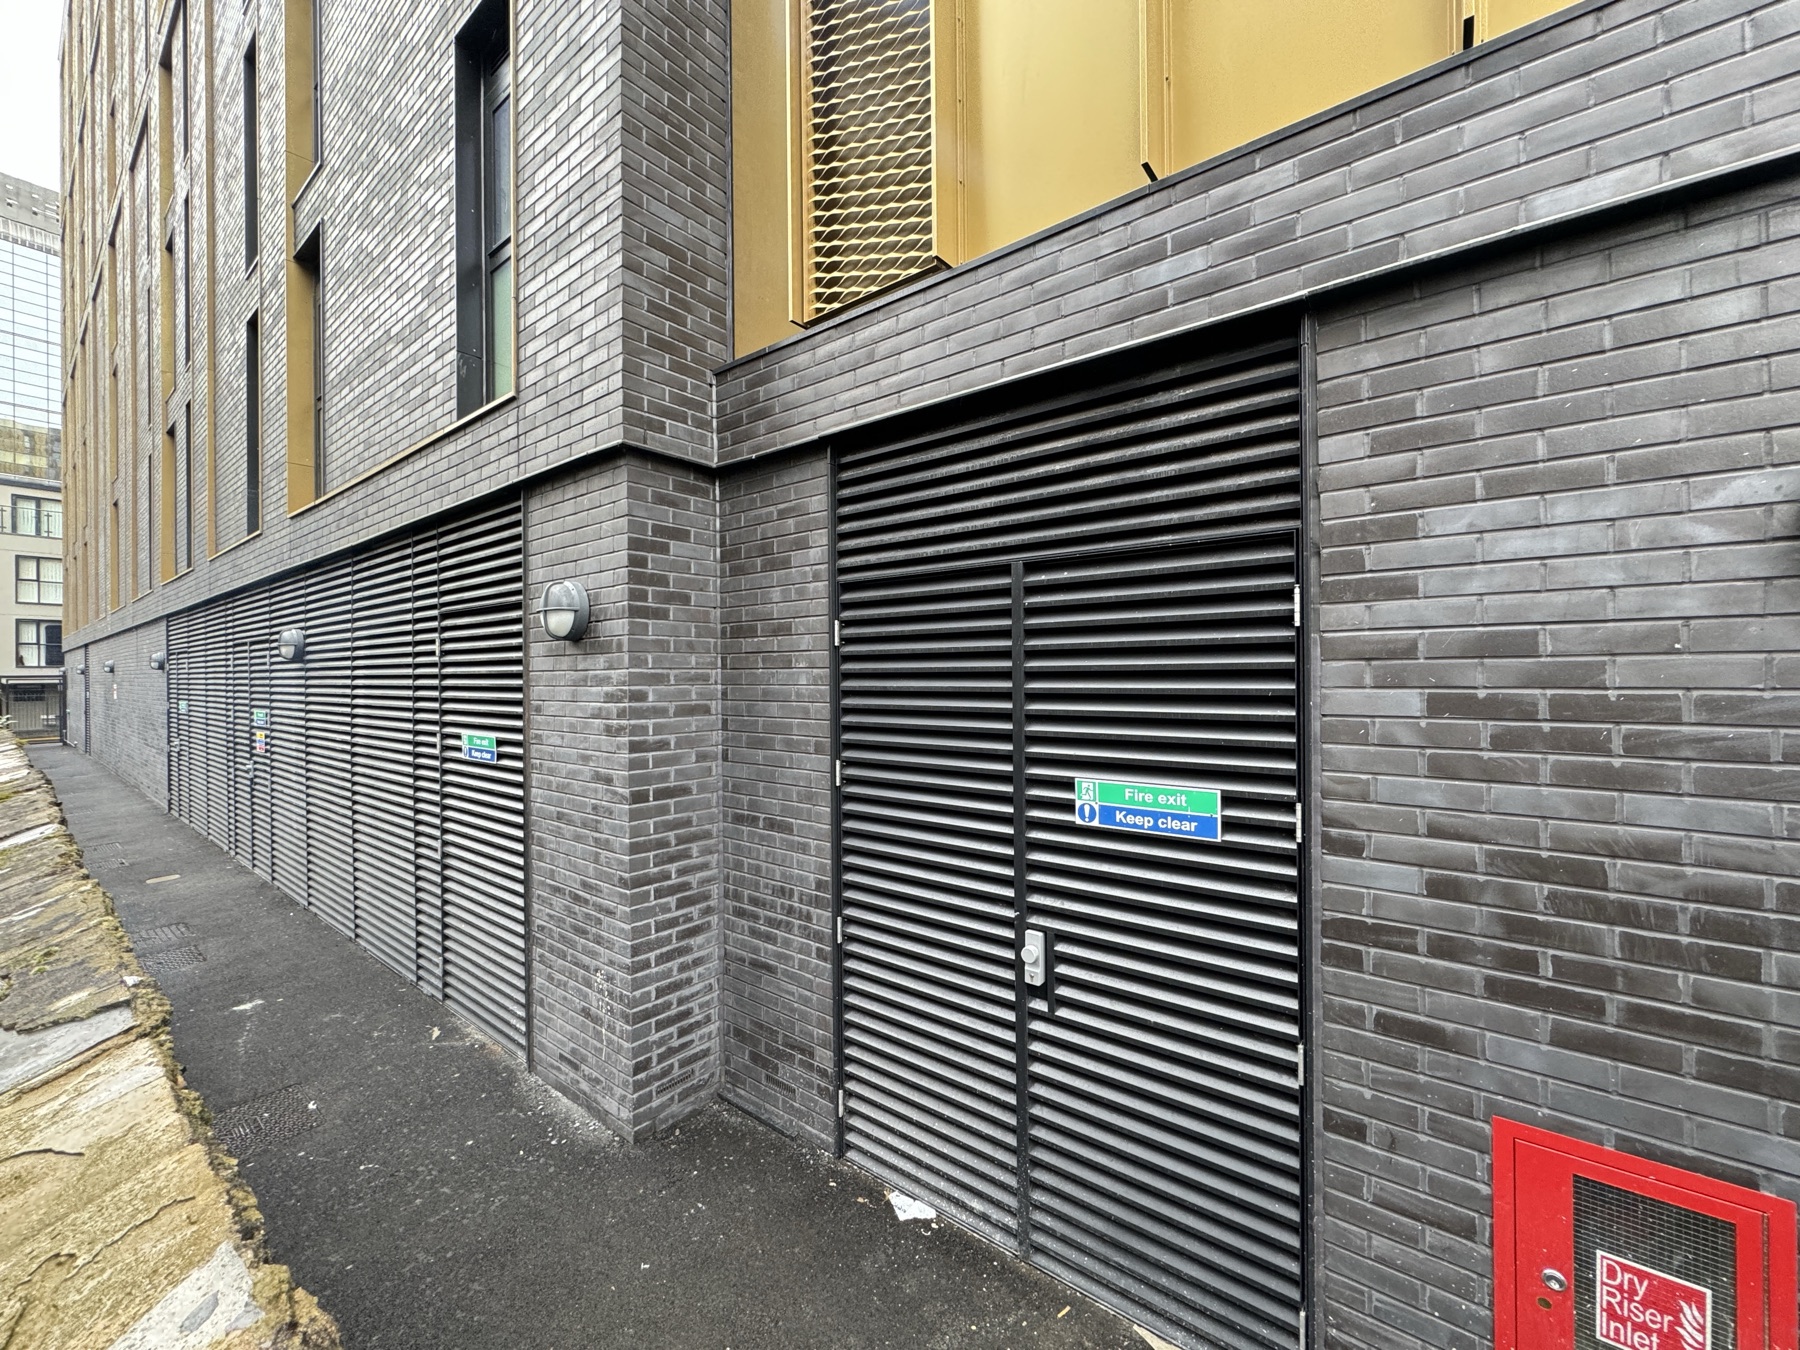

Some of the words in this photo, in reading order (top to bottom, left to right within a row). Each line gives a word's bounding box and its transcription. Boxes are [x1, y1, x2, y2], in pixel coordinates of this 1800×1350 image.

[1124, 788, 1154, 803] Fire
[1157, 793, 1187, 807] exit
[1115, 810, 1154, 829] Keep
[1158, 816, 1198, 832] clear
[1602, 1259, 1648, 1300] Dry
[1601, 1285, 1674, 1333] Riser
[1601, 1312, 1660, 1350] Inlet
